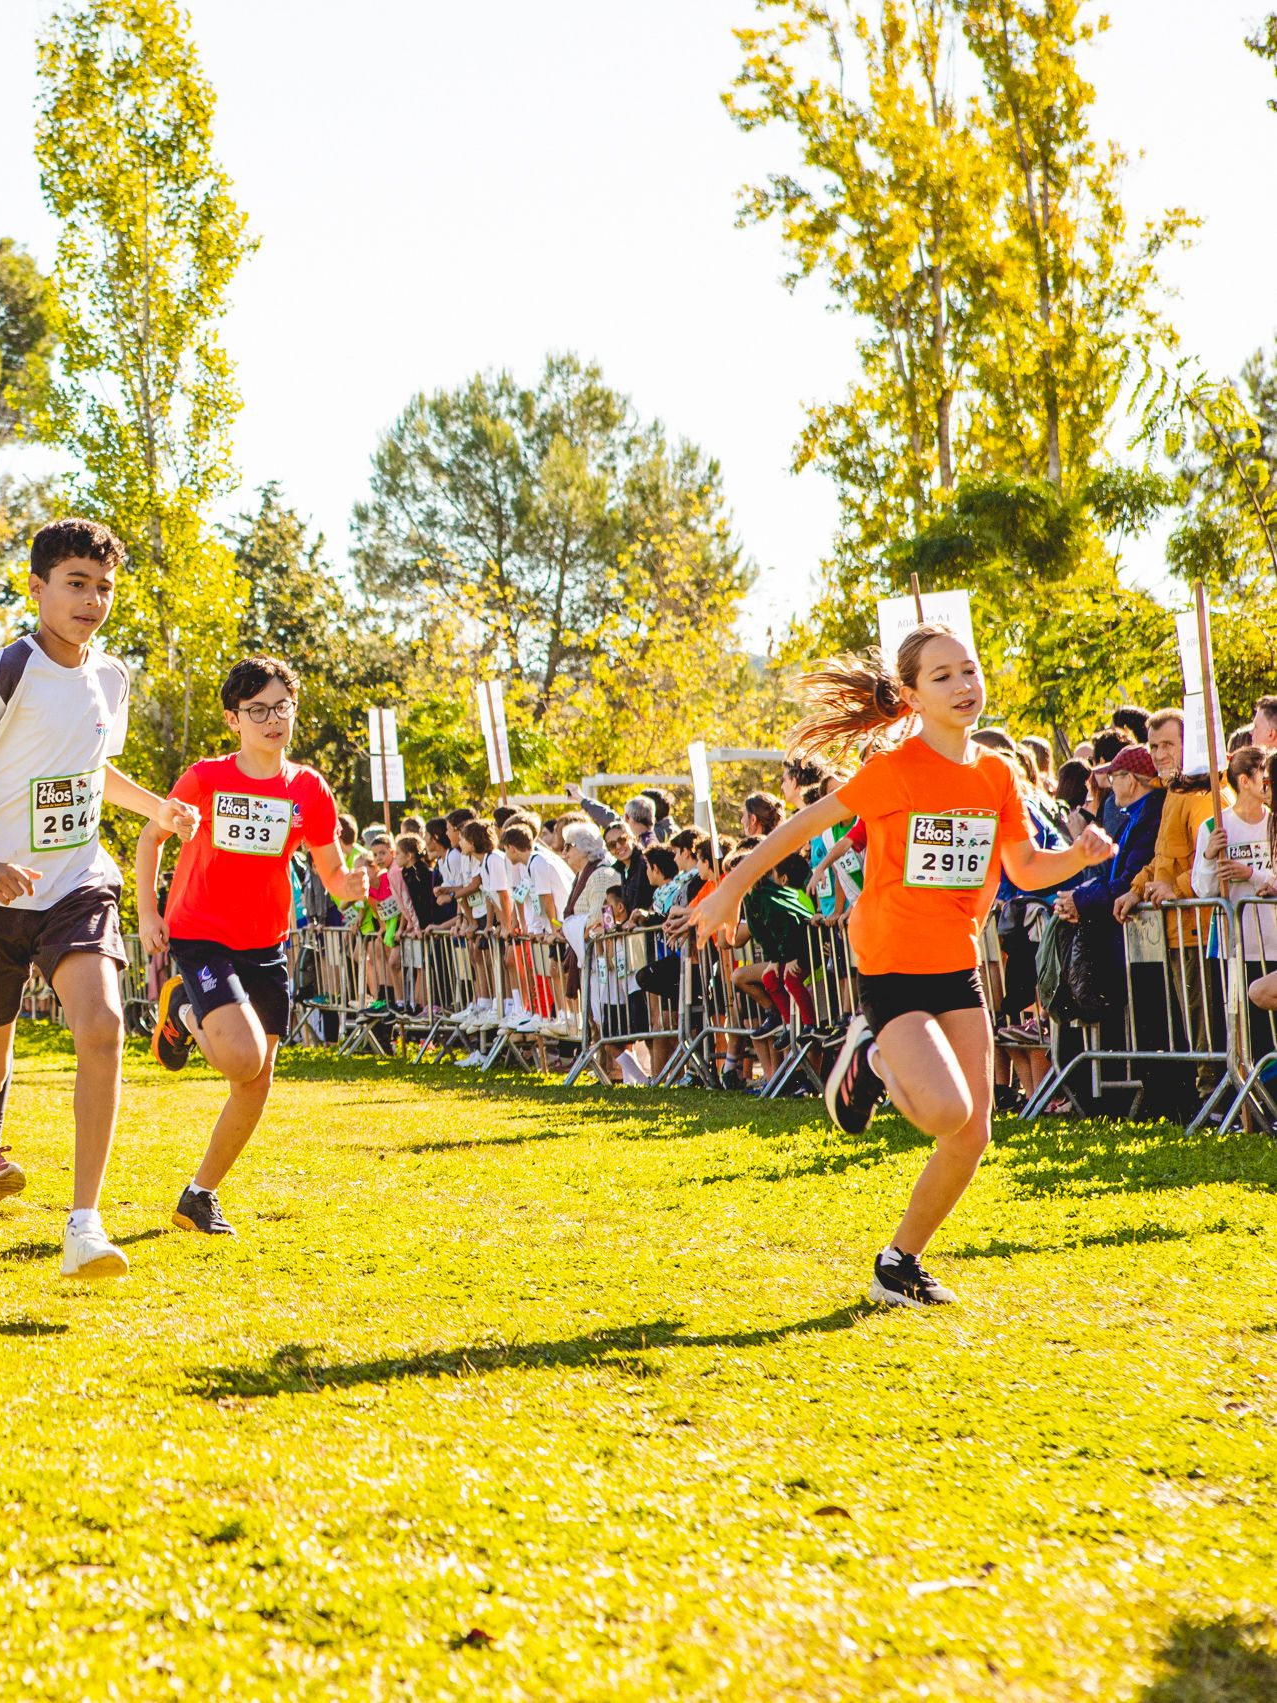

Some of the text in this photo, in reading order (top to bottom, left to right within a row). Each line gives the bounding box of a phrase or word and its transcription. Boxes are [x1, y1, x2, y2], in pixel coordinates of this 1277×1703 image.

[38, 790, 72, 805] CROS
[218, 804, 248, 816] CROS
[44, 806, 96, 834] 2644
[228, 824, 271, 842] 833
[915, 828, 952, 842] CROS
[922, 853, 979, 872] 2916
